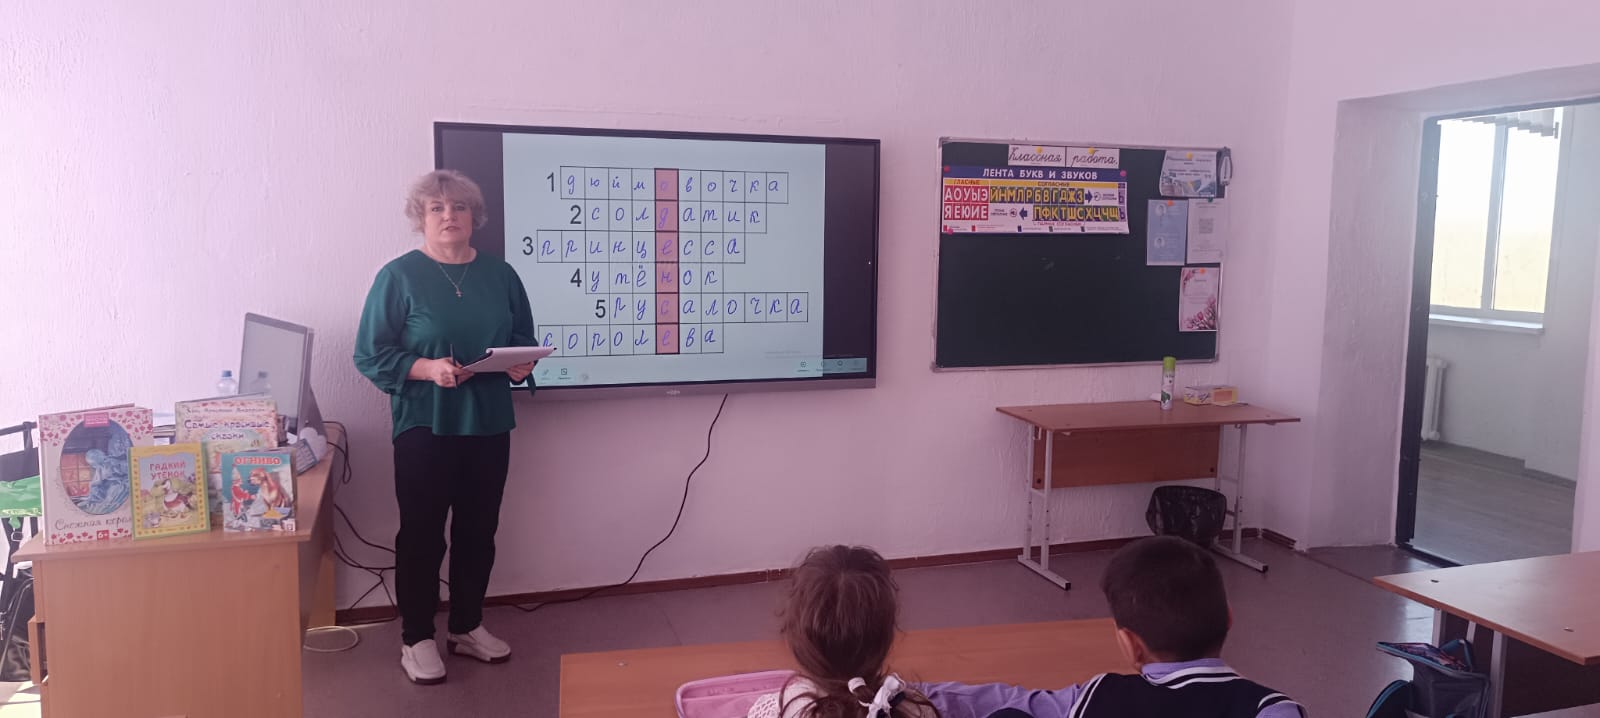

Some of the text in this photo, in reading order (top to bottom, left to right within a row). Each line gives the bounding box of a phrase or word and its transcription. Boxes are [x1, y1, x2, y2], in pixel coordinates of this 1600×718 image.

[1008, 147, 1062, 162] Классная
[546, 171, 555, 192] 1
[982, 168, 1098, 180] ЛЕНТА БУКВ И ЗВУКОВ
[569, 204, 582, 225] 2
[522, 236, 534, 256] 3
[570, 268, 582, 288] 4
[595, 299, 606, 319] 5
[149, 460, 186, 472] ГАДКИЙ
[234, 456, 281, 465] ОГНИВО
